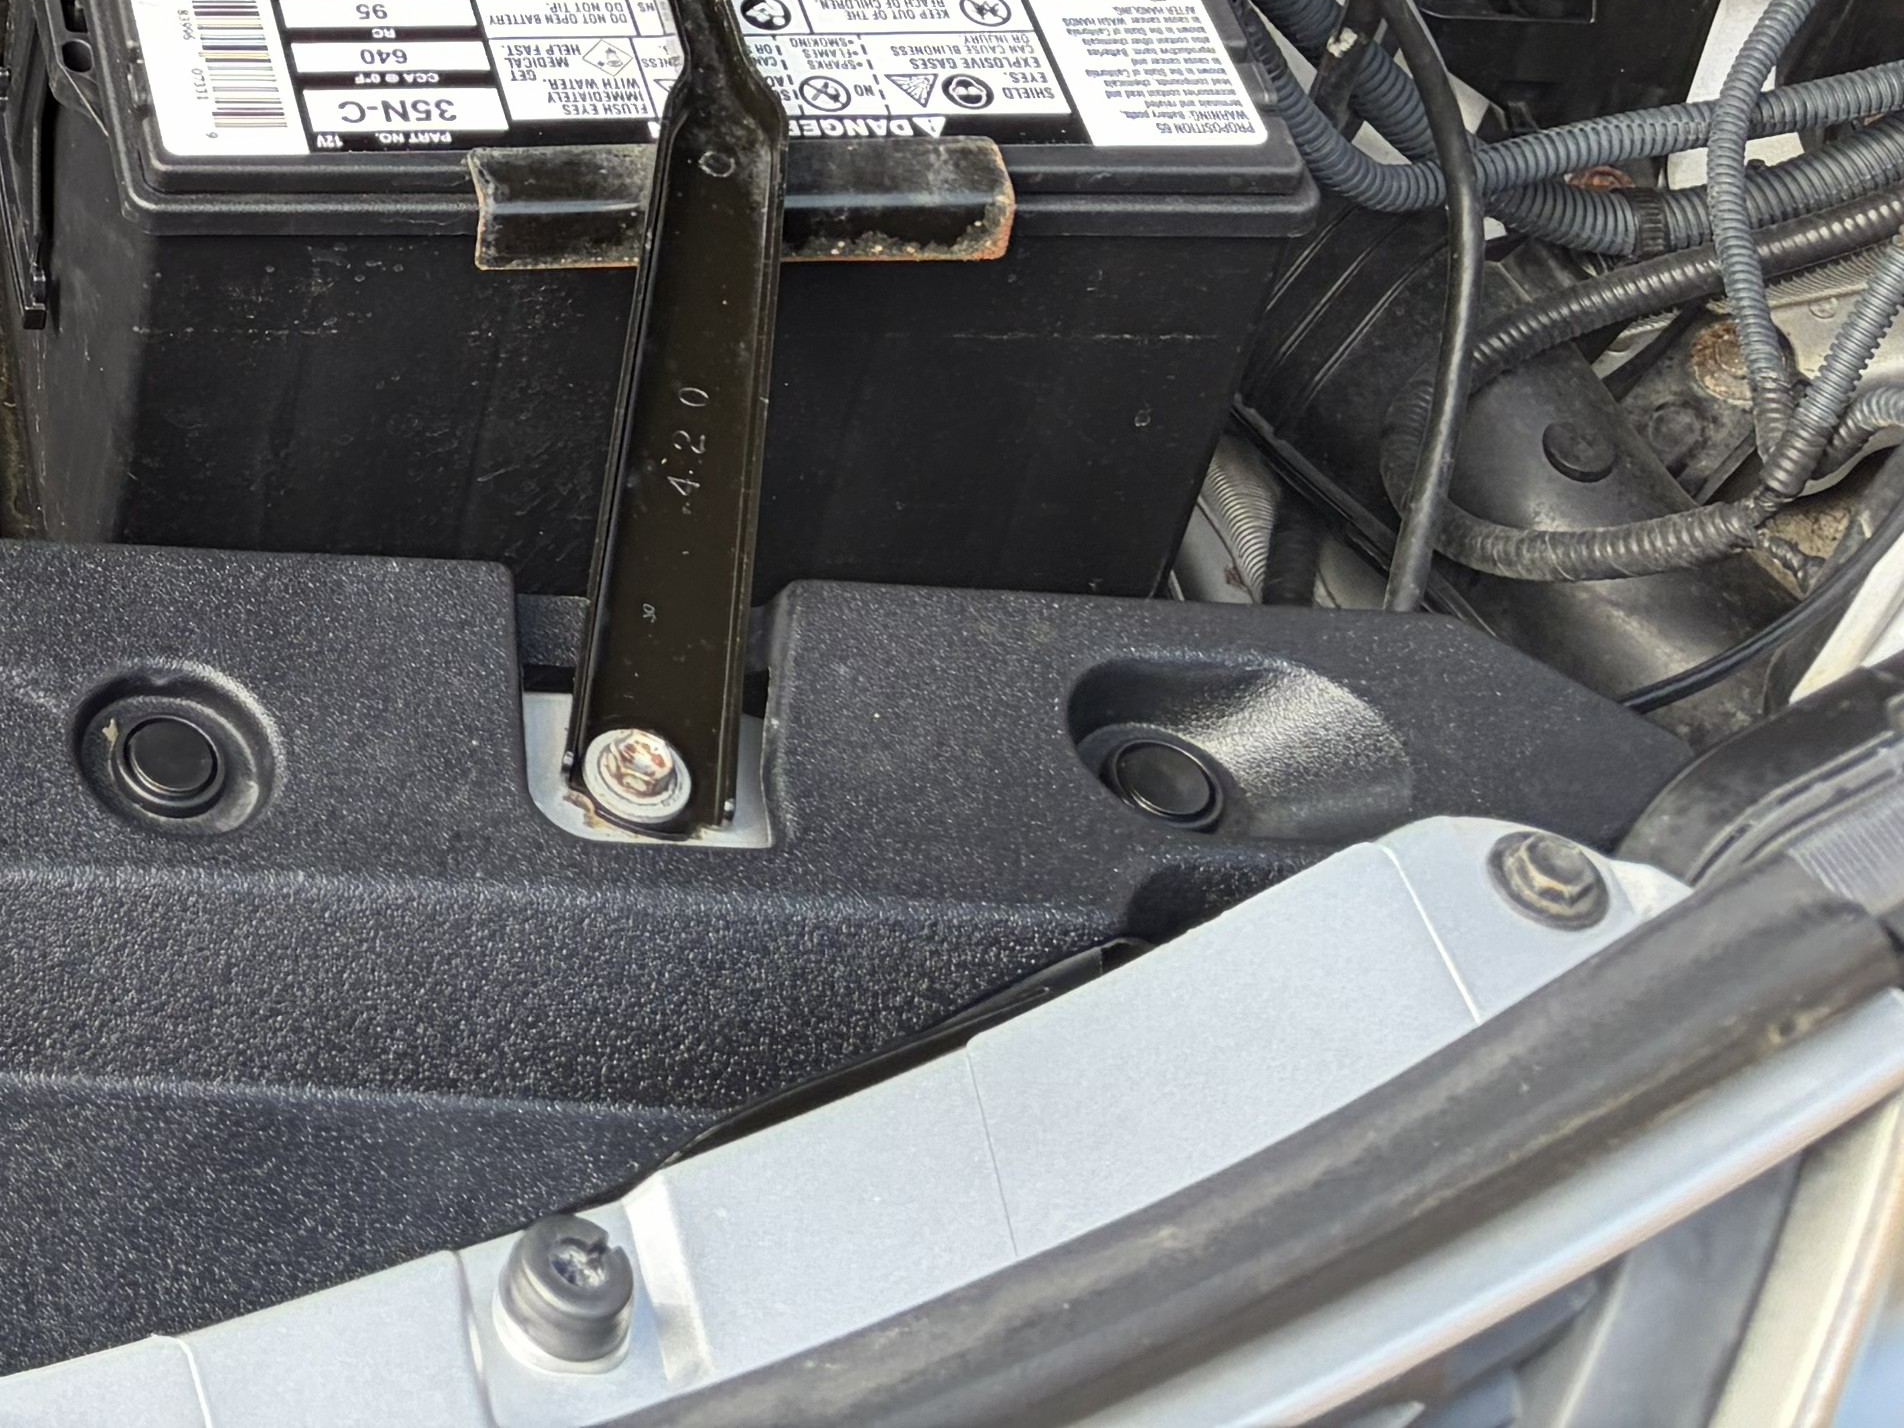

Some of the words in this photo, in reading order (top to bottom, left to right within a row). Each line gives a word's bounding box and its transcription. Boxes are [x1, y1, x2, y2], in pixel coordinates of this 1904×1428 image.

[355, 4, 388, 20] 95
[545, 2, 570, 13] TIP.
[574, 2, 599, 13] NOT
[605, 2, 623, 13] DO
[544, 13, 578, 24] OPEN
[582, 13, 606, 24] NOT
[608, 13, 628, 24] DO
[845, 10, 868, 20] THE
[872, 10, 888, 20] OF
[892, 9, 915, 20] OUT
[920, 9, 950, 19] KEEP
[371, 27, 396, 38] RC
[1012, 34, 1030, 44] OR
[501, 45, 542, 56] FAST.
[545, 44, 581, 55] HELP
[890, 45, 961, 56] BLINDNESS
[963, 45, 1006, 55] CAUSE
[1008, 44, 1035, 54] CAN
[360, 48, 408, 64] 640
[504, 56, 569, 68] MEDICAL
[908, 58, 958, 69] GASES
[960, 56, 1042, 69] EXPLOSIVE
[403, 72, 440, 83] CCA
[510, 69, 537, 81] GET
[1003, 71, 1049, 84] EYES.
[542, 78, 599, 90] WATER.
[602, 77, 640, 90] WITH
[853, 84, 875, 96] NO
[1002, 87, 1055, 99] SHIELD
[547, 90, 644, 104] IMMEDIATELY
[338, 98, 457, 124] 35N-C
[562, 104, 599, 115] EYES
[602, 103, 648, 115] FLUSH
[1155, 123, 1173, 133] 65
[1173, 122, 1256, 133] PROPOSITION
[316, 134, 344, 147] 12V
[374, 131, 404, 143] NO.
[407, 130, 451, 143] PART
